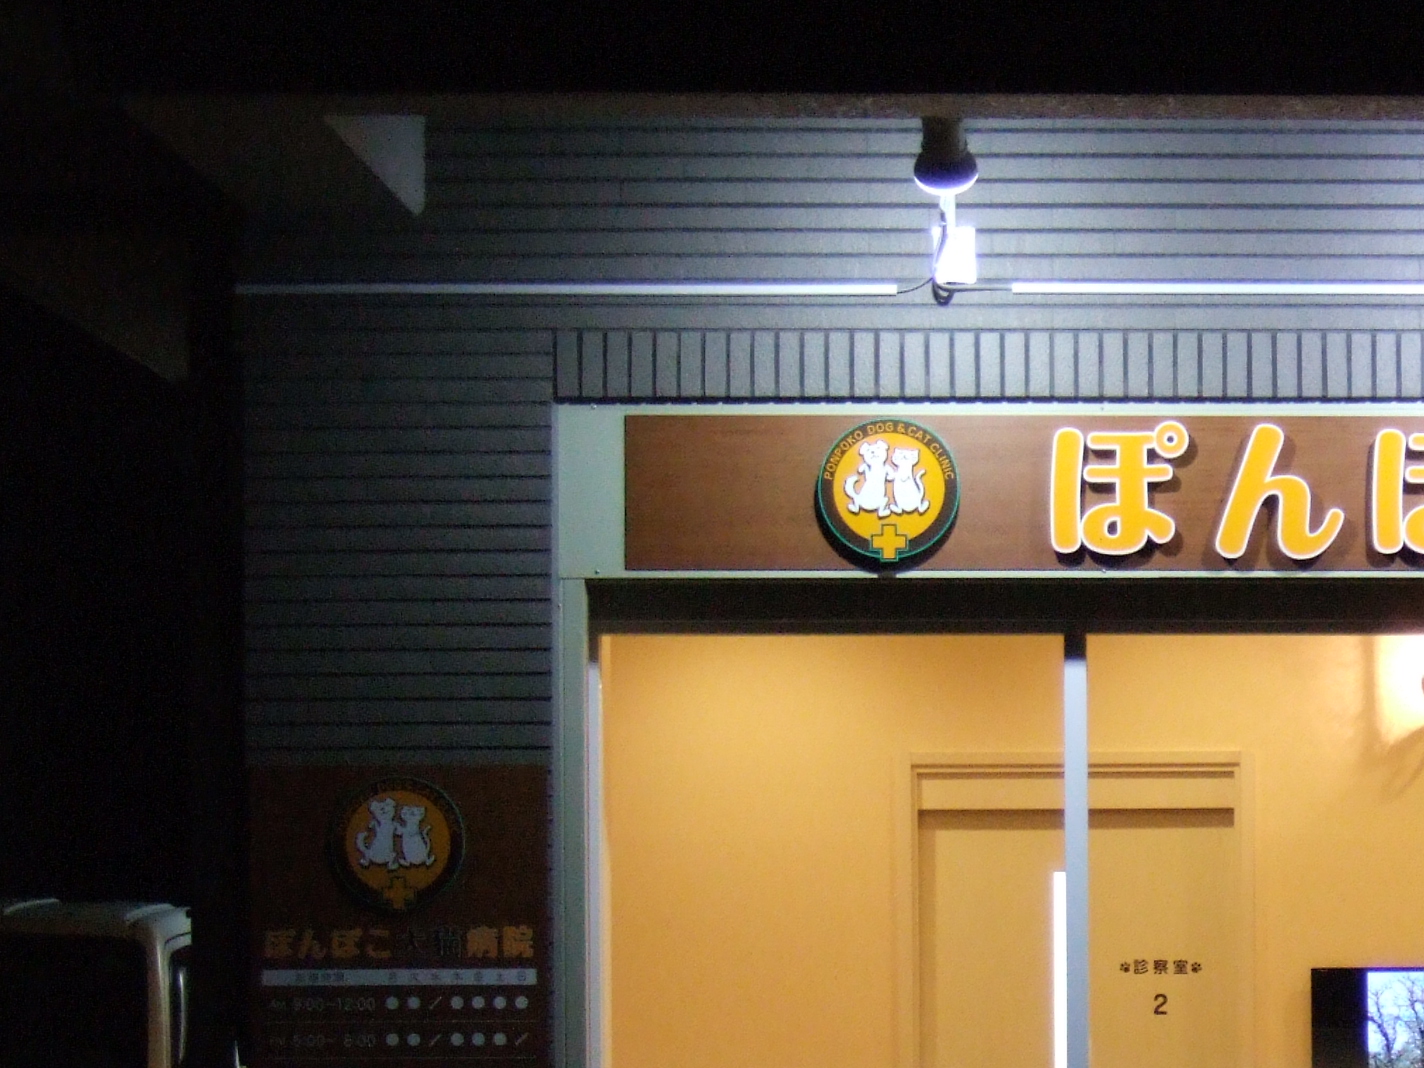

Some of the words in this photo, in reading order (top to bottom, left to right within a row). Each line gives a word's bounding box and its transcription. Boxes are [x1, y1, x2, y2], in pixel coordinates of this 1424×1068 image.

[823, 429, 864, 481] PONPOKO
[867, 421, 894, 434] DOG
[908, 426, 931, 443] CAT
[930, 442, 955, 480] CLINIC
[1132, 958, 1190, 976] 診察室
[1153, 993, 1169, 1016] 2
